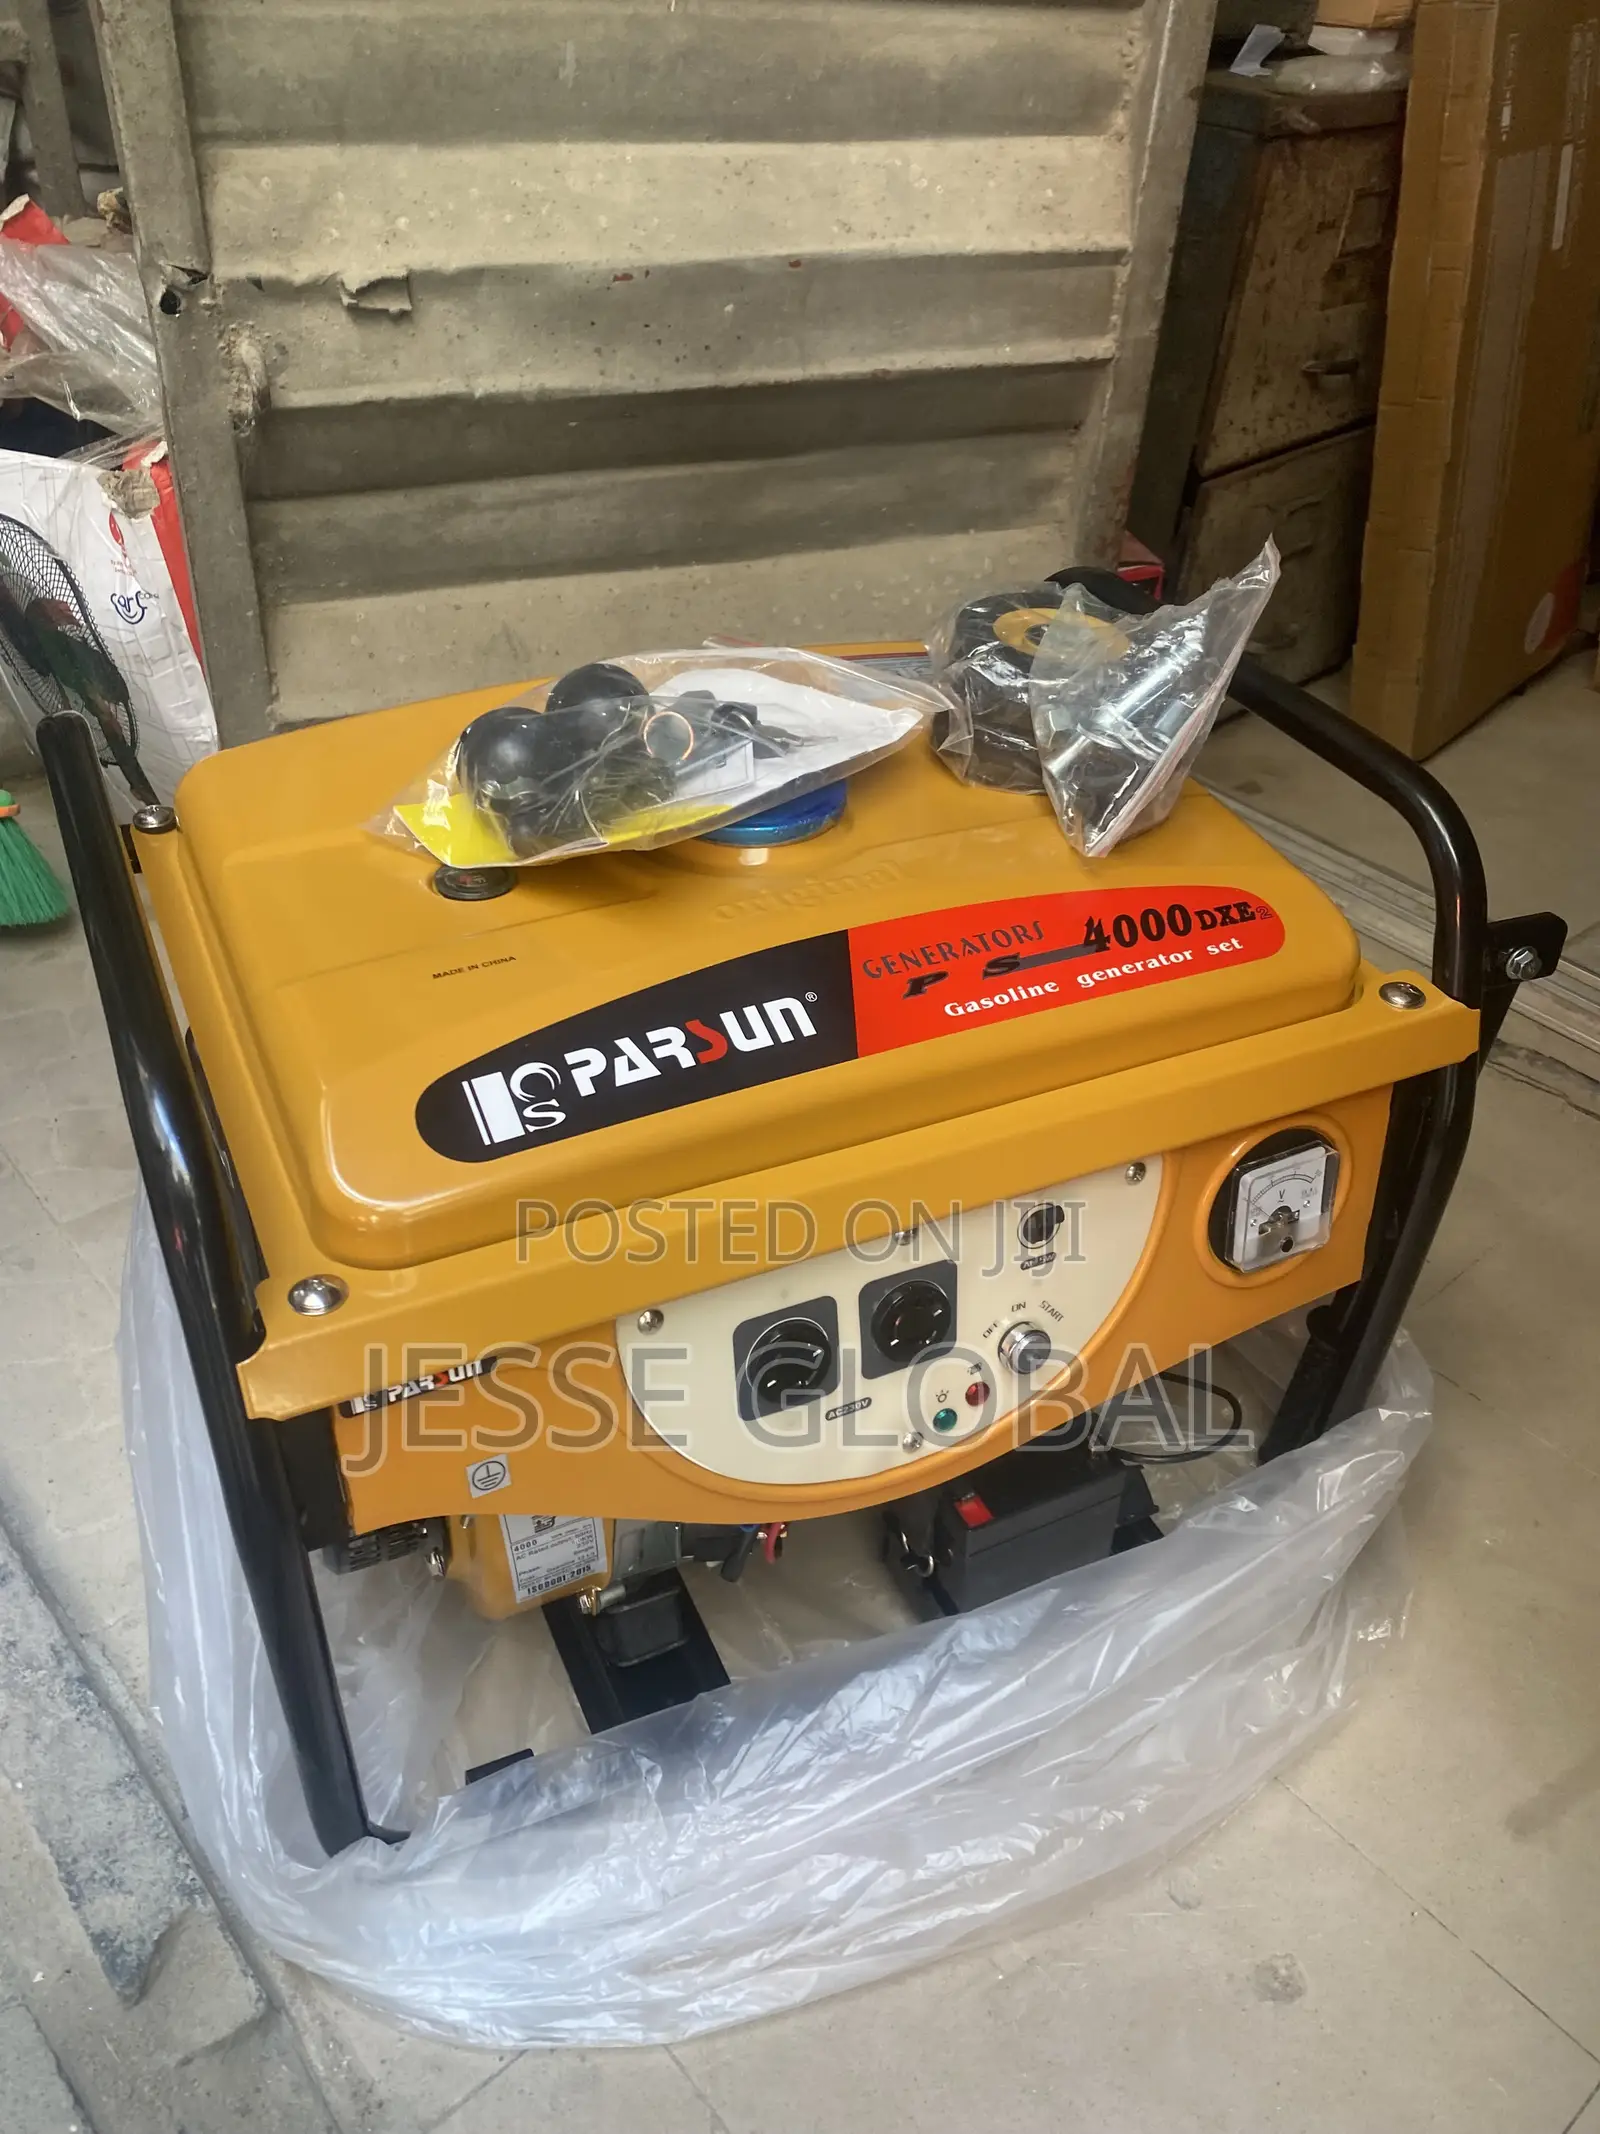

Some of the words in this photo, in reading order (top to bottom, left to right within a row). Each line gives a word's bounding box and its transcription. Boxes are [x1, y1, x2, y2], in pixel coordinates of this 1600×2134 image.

[862, 920, 1045, 979] GENERATORS
[432, 967, 464, 979] MADE
[467, 963, 479, 971] IN
[481, 956, 517, 968] CHINA
[943, 977, 1060, 1018] Gasoline
[1076, 947, 1193, 988] generator
[1207, 936, 1244, 957] set
[563, 997, 817, 1097] PARSUN
[1011, 1302, 1026, 1312] ON
[1040, 1300, 1064, 1322] START
[982, 1320, 999, 1338] OFF
[388, 1360, 483, 1403] PARSUN
[828, 1400, 869, 1419] AC230V
[513, 1539, 538, 1552] 4000
